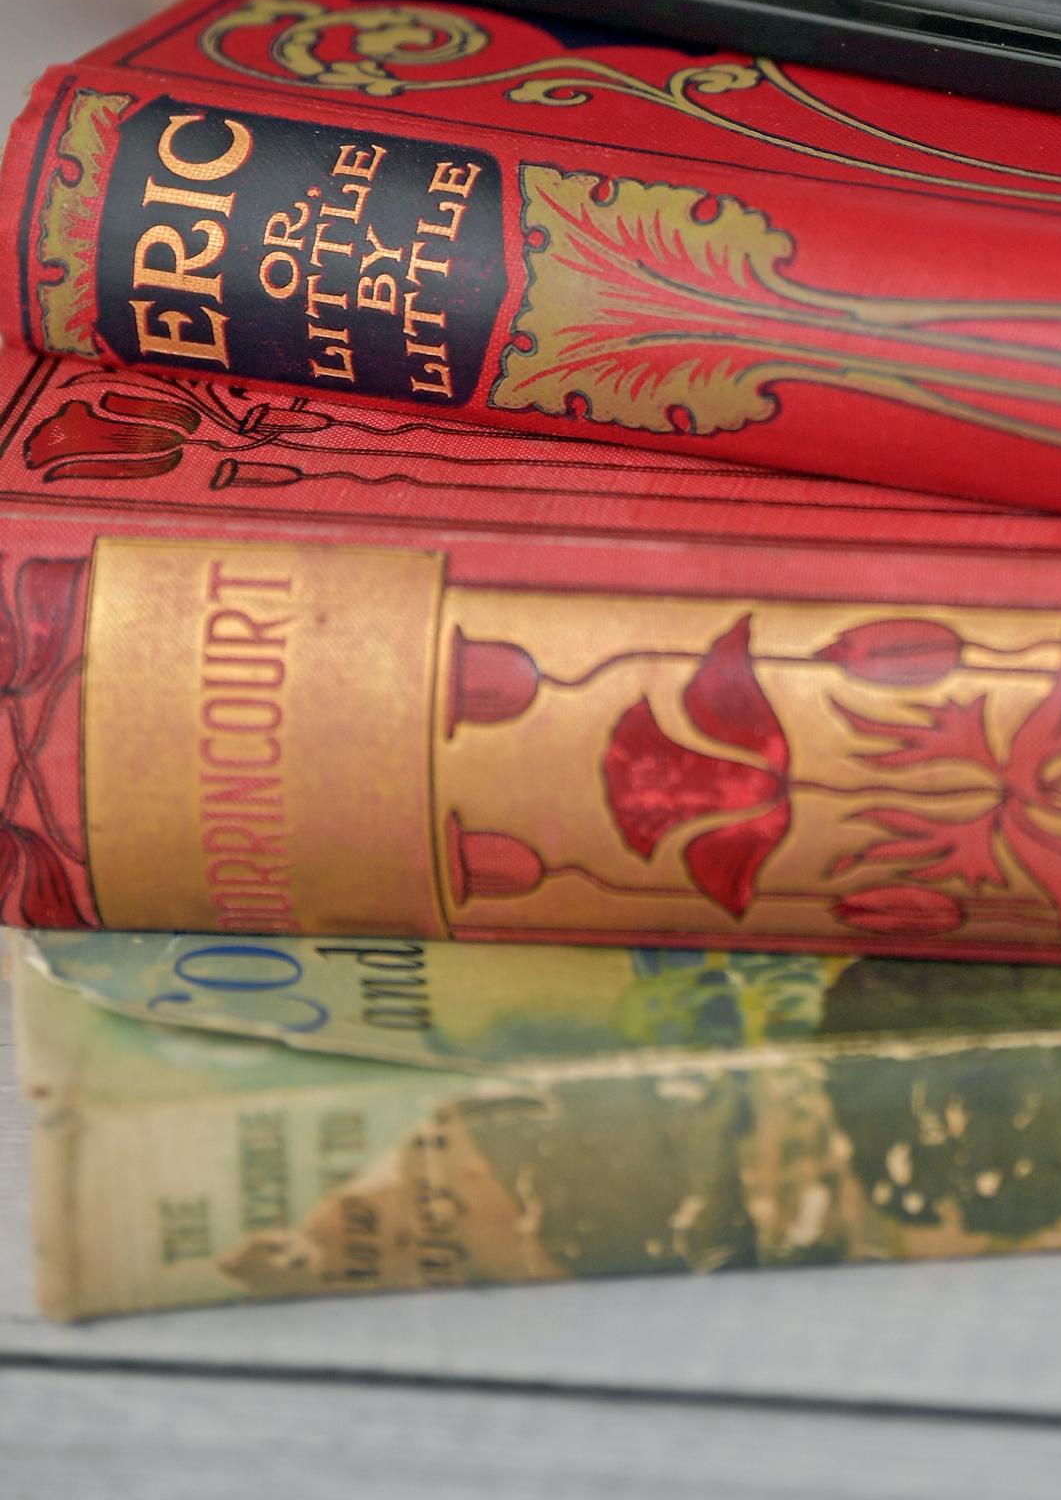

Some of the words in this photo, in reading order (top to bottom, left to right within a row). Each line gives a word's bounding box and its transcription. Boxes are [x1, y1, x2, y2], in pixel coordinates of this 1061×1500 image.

[128, 113, 254, 370] ERIC
[306, 143, 389, 383] LITTLE
[357, 224, 403, 315] BY
[403, 160, 483, 399] LITTLE
